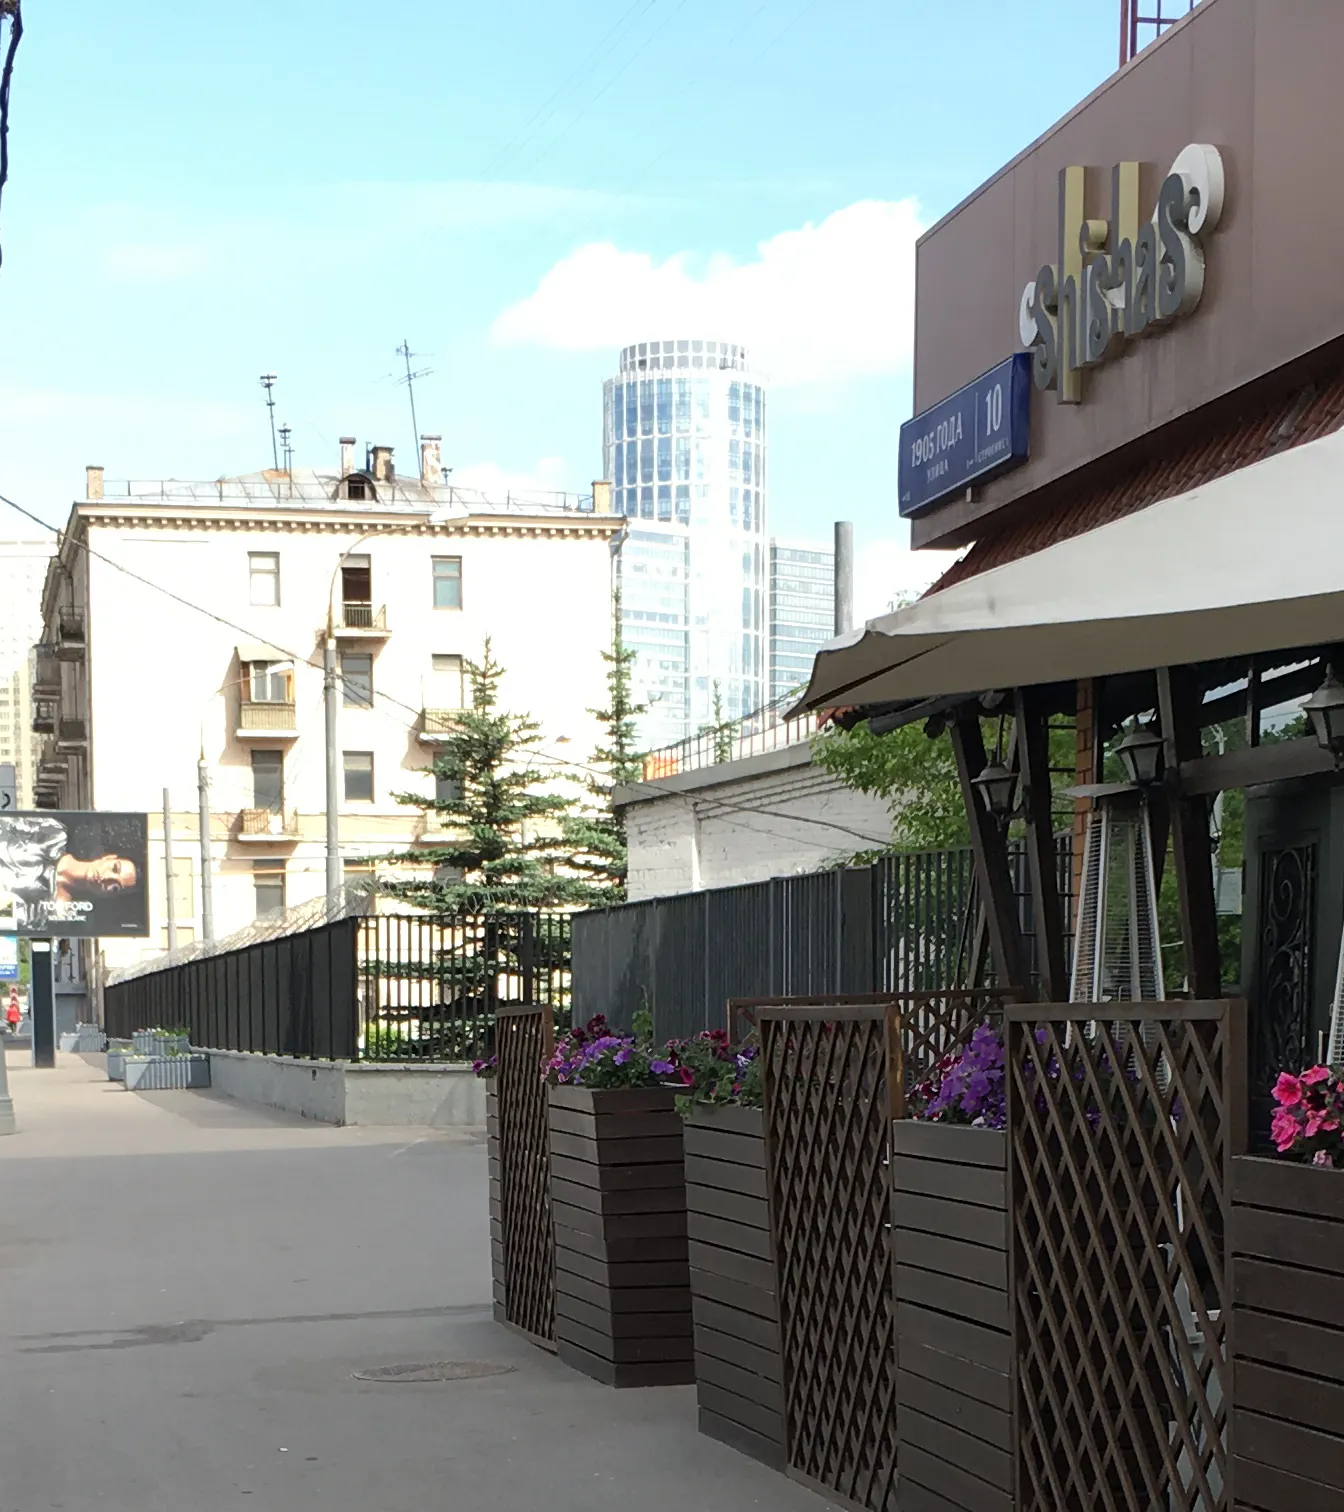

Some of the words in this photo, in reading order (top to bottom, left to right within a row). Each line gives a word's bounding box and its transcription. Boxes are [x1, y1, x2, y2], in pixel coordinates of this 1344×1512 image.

[985, 383, 1002, 436] 10
[911, 431, 935, 468] 1905
[936, 412, 963, 453] ГОДА
